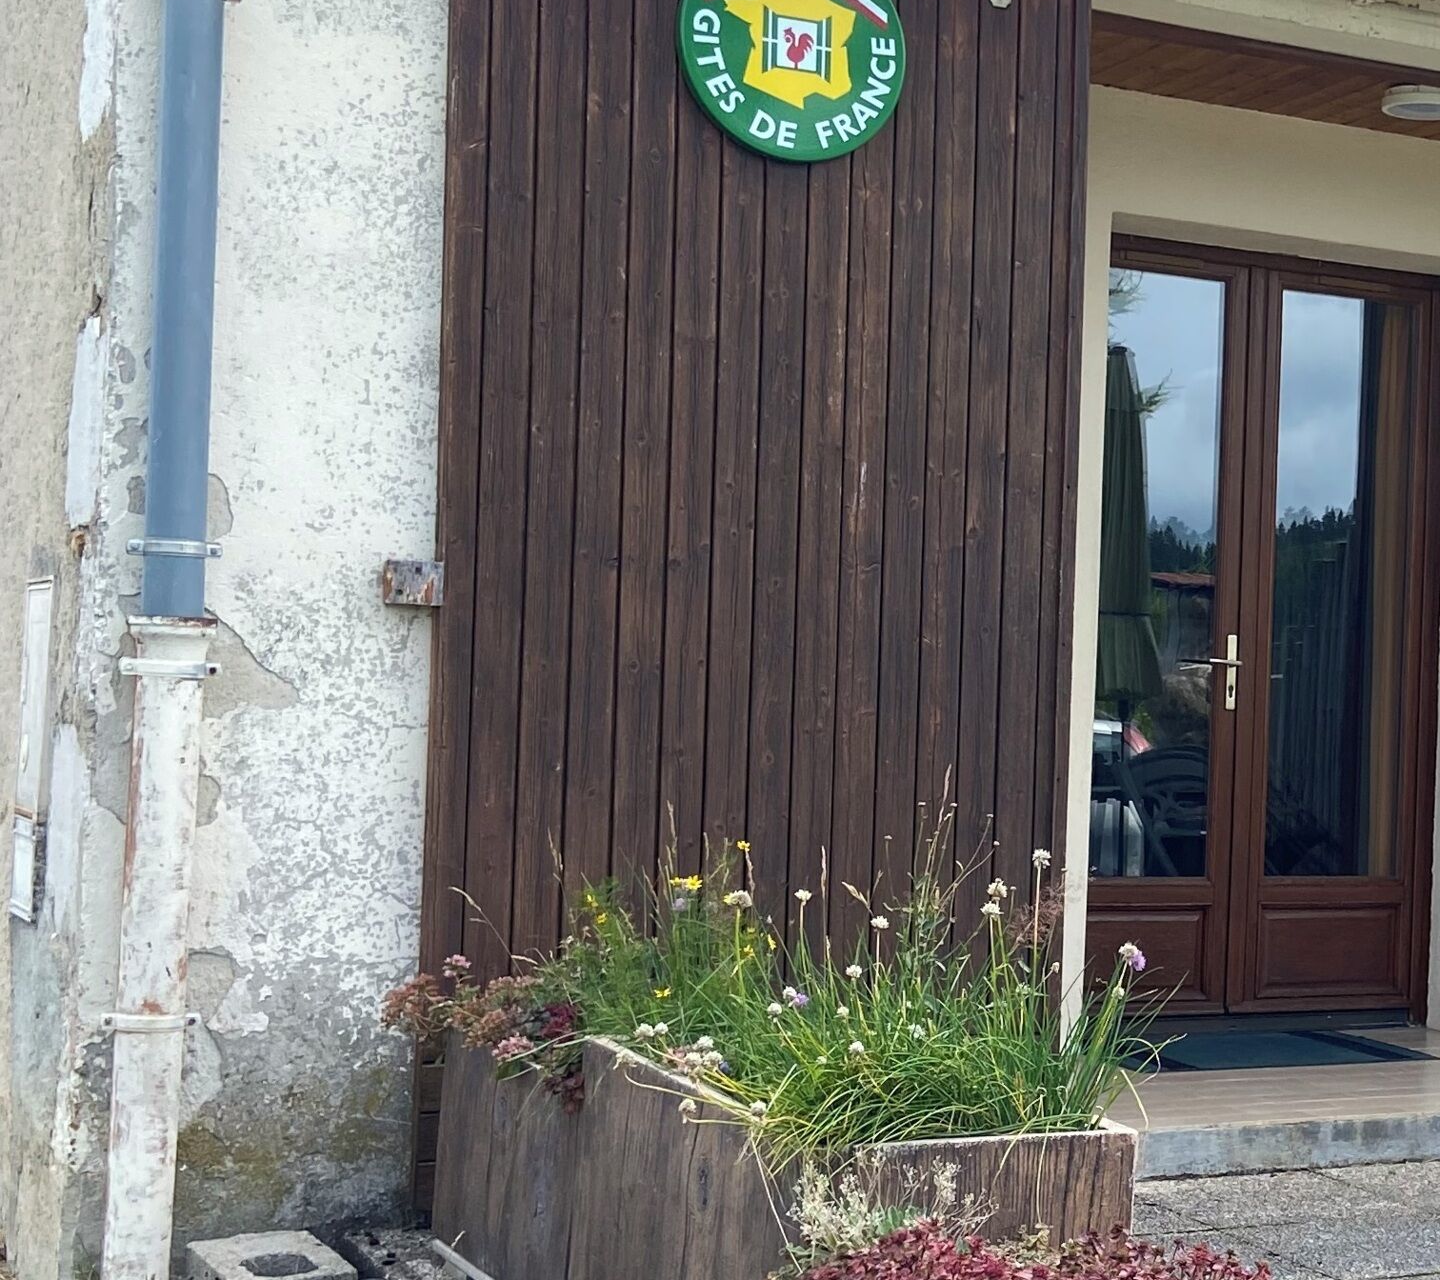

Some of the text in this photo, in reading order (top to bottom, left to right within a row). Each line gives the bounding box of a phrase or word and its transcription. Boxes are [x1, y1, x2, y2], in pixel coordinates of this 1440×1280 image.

[693, 9, 896, 149] GITES DE FRANCE
